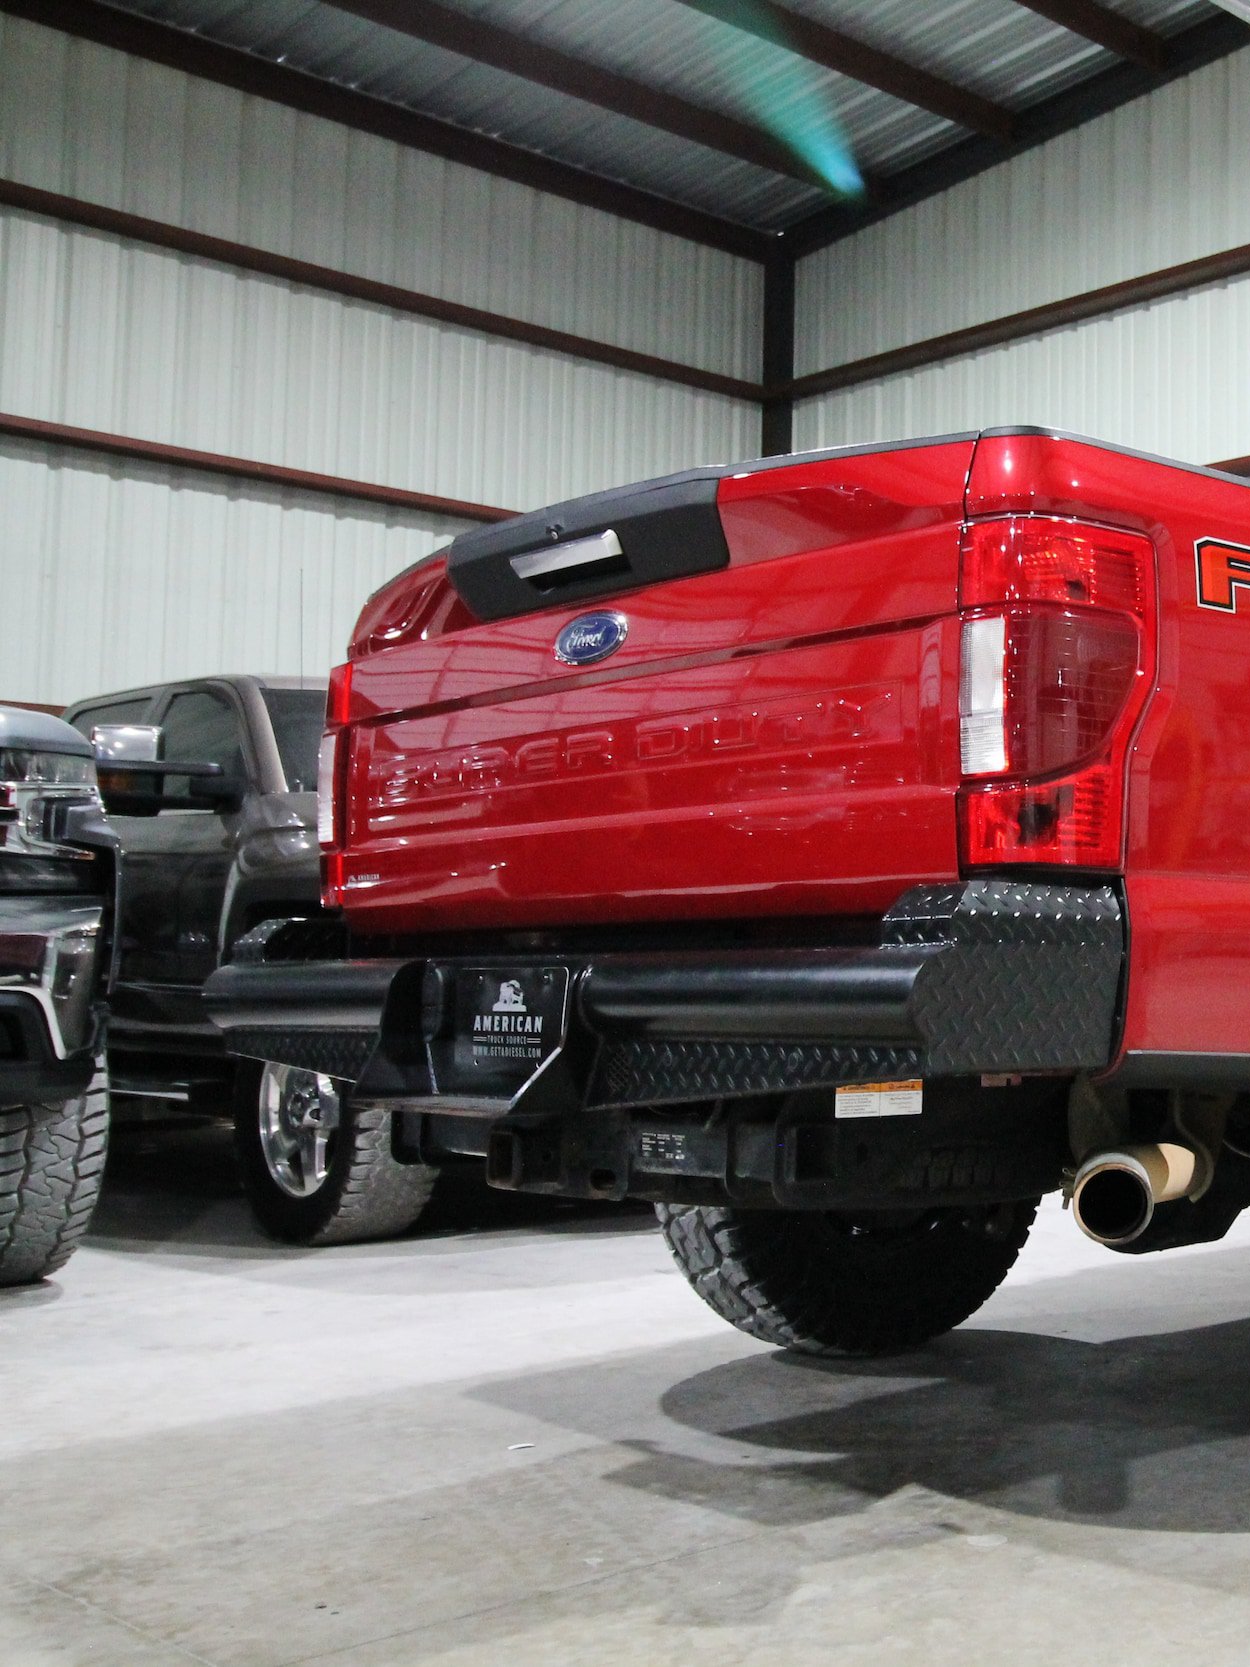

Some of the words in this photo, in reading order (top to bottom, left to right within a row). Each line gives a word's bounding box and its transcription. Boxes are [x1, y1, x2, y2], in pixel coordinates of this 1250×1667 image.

[566, 621, 606, 653] Ford
[635, 692, 893, 761] DUTY
[473, 1015, 543, 1033] AMERICAN
[487, 1034, 504, 1044] TRUCK
[506, 1035, 527, 1045] SOURCE
